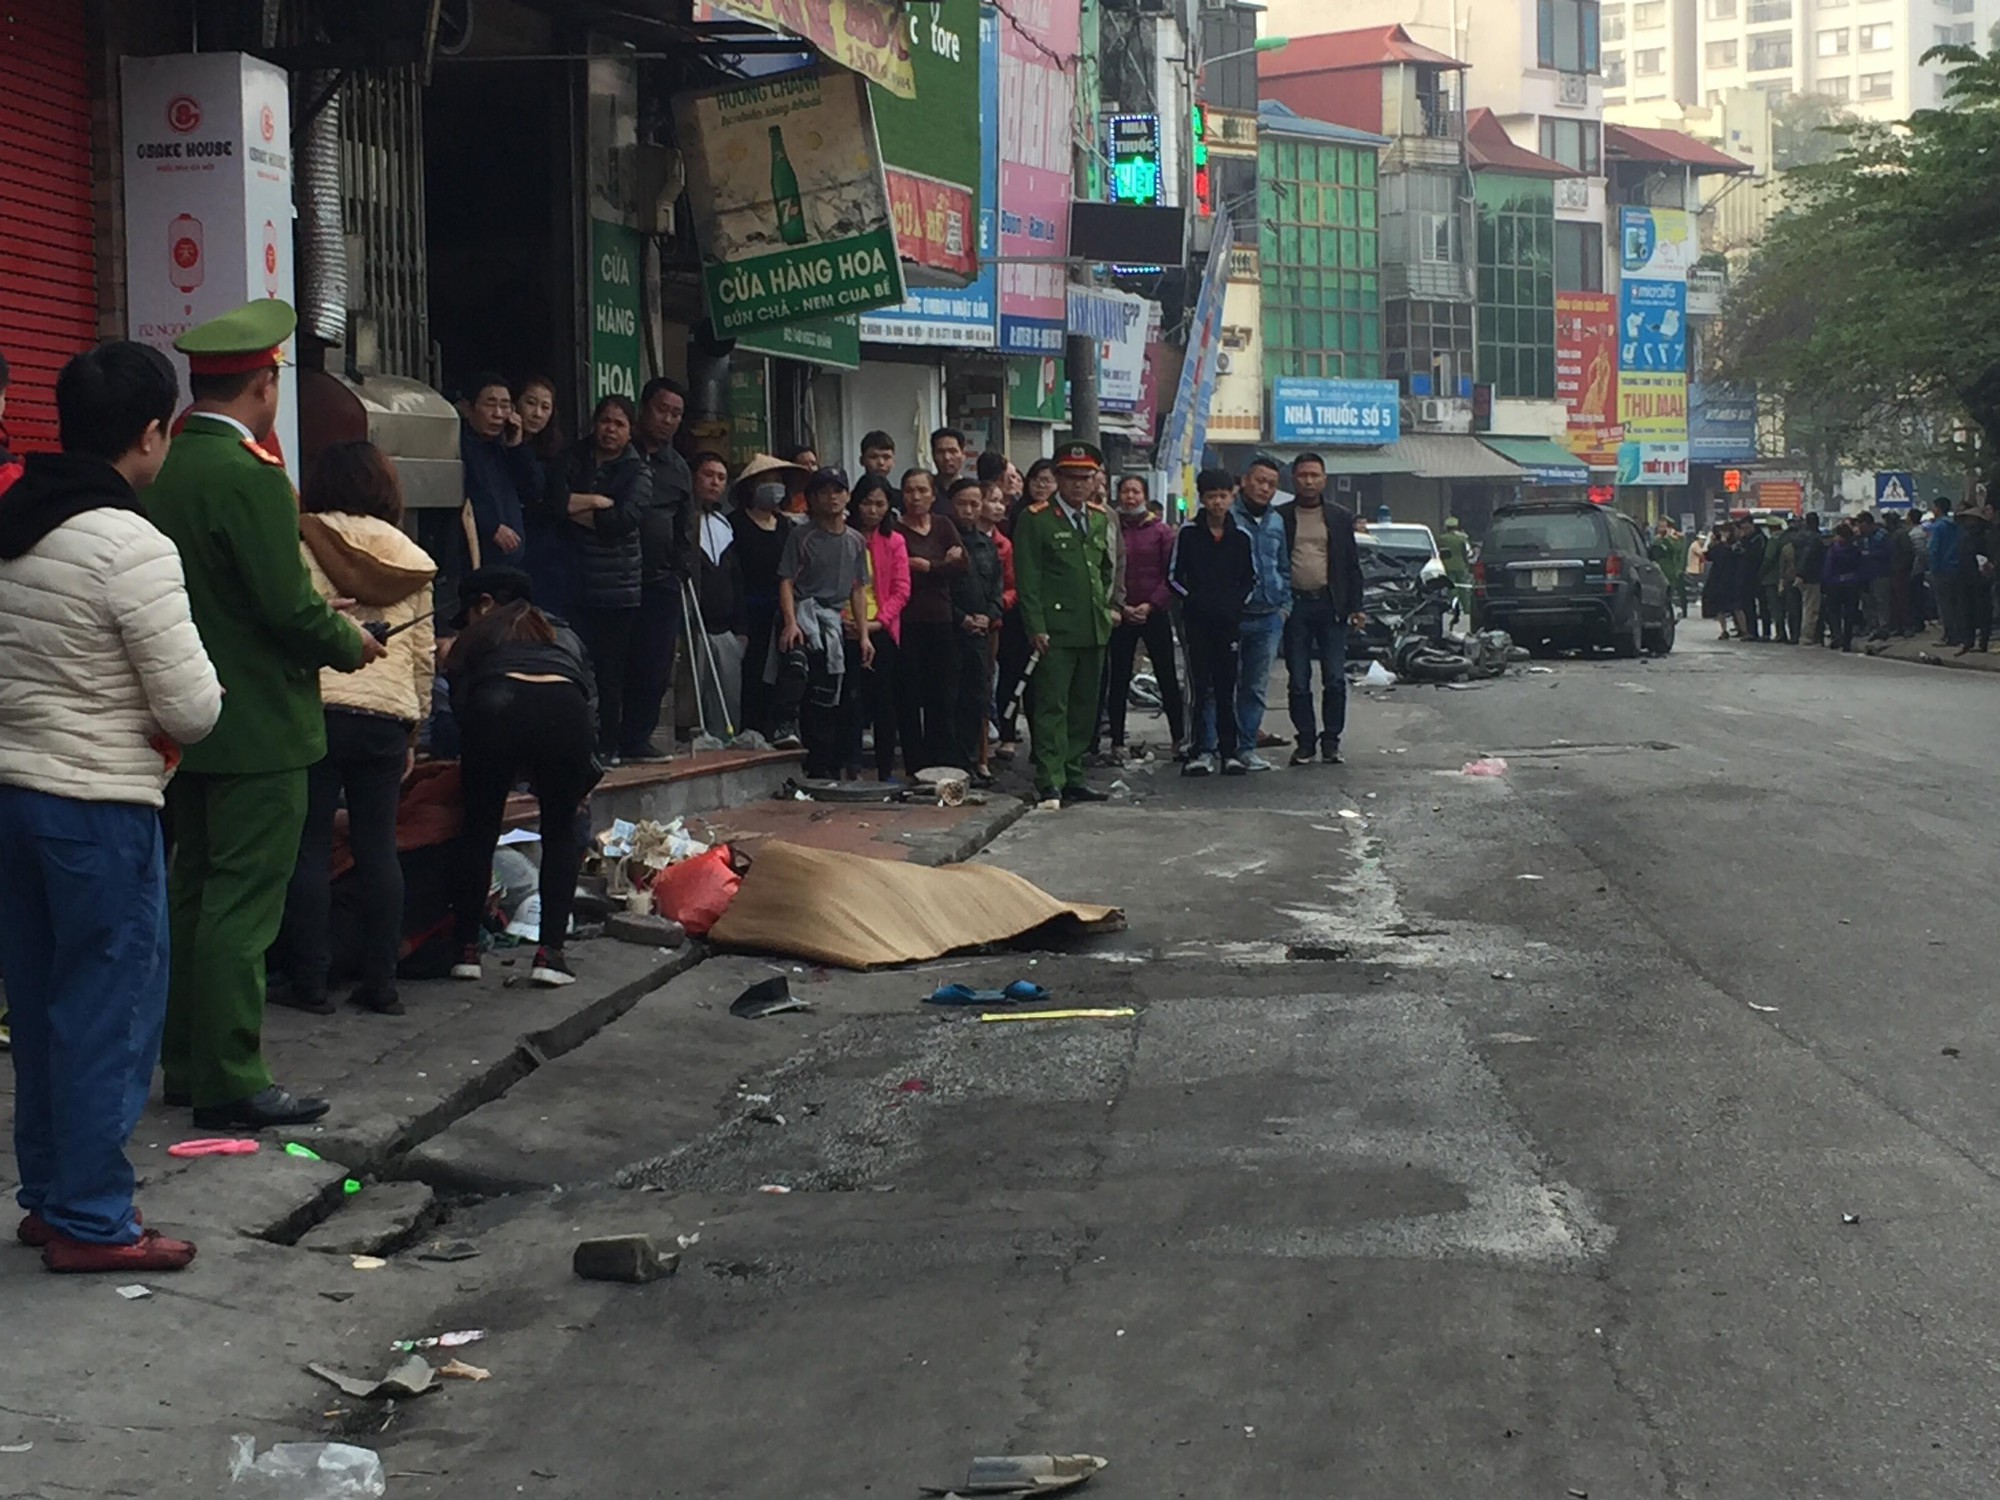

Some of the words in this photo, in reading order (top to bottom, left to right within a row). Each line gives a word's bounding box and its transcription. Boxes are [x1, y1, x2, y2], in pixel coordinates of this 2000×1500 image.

[185, 141, 233, 158] HOUSE
[601, 246, 631, 286] CỬA
[718, 266, 766, 304] CỬA
[768, 258, 834, 295] HÀNG
[837, 247, 888, 281] HOA
[596, 298, 636, 338] HÀNG
[723, 308, 753, 329] BÚN
[757, 299, 791, 321] CHẢ
[802, 294, 835, 312] NEM
[838, 286, 871, 305] CUA
[597, 362, 636, 402] HOA
[1284, 403, 1314, 425] NHÀ
[1316, 401, 1359, 426] THUỐC
[1361, 401, 1380, 426] SỐ
[1382, 408, 1391, 427] 5
[1623, 393, 1653, 418] THU
